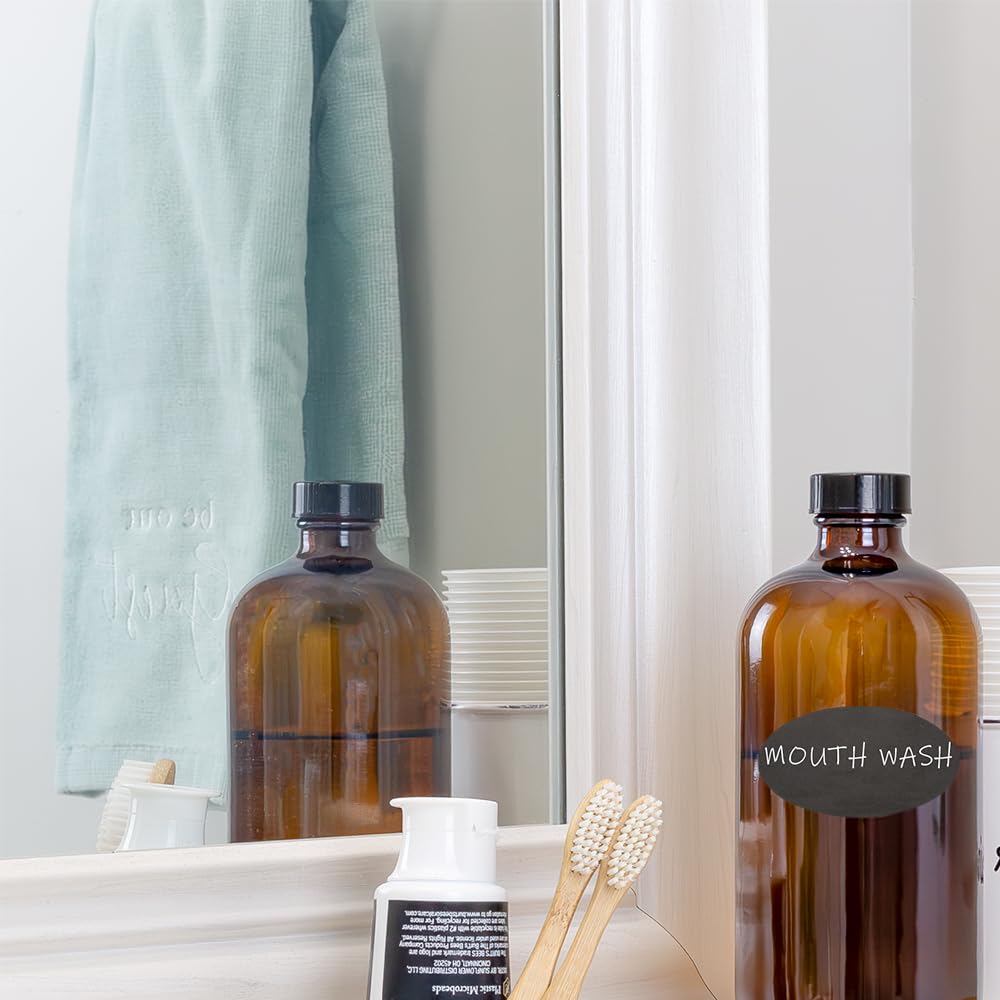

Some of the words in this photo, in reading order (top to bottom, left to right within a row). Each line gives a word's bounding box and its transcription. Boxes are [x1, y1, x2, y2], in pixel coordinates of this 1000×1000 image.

[764, 741, 867, 769] MOUTH
[879, 741, 954, 769] WASH
[428, 924, 449, 932] plastics
[399, 940, 424, 948] Company
[419, 948, 431, 956] logo
[432, 985, 478, 995] Microbeads
[480, 985, 501, 995] Plastic
